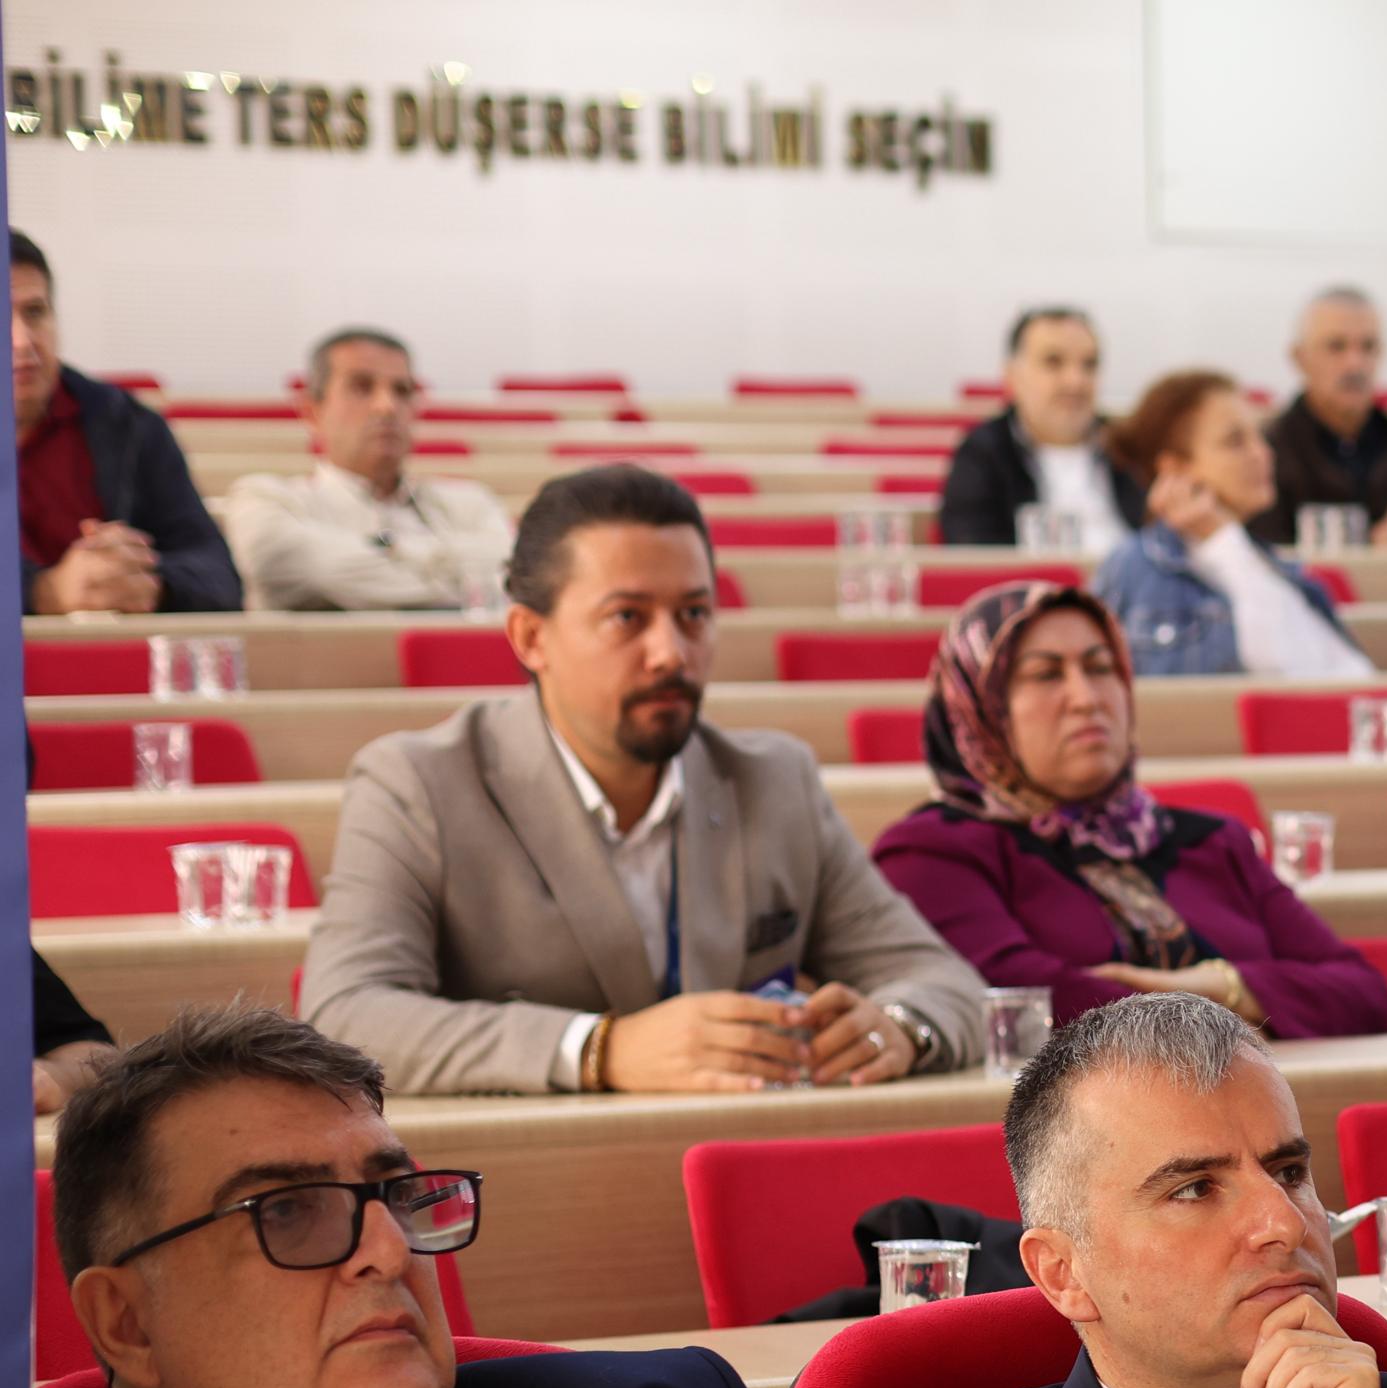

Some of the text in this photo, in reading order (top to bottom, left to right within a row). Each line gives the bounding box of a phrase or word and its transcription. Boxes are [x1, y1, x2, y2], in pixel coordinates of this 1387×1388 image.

[236, 84, 370, 152] TERS
[394, 64, 639, 174] DÜŞERSE
[663, 76, 826, 170] BİLİMİ
[848, 90, 992, 192] SEÇİN
